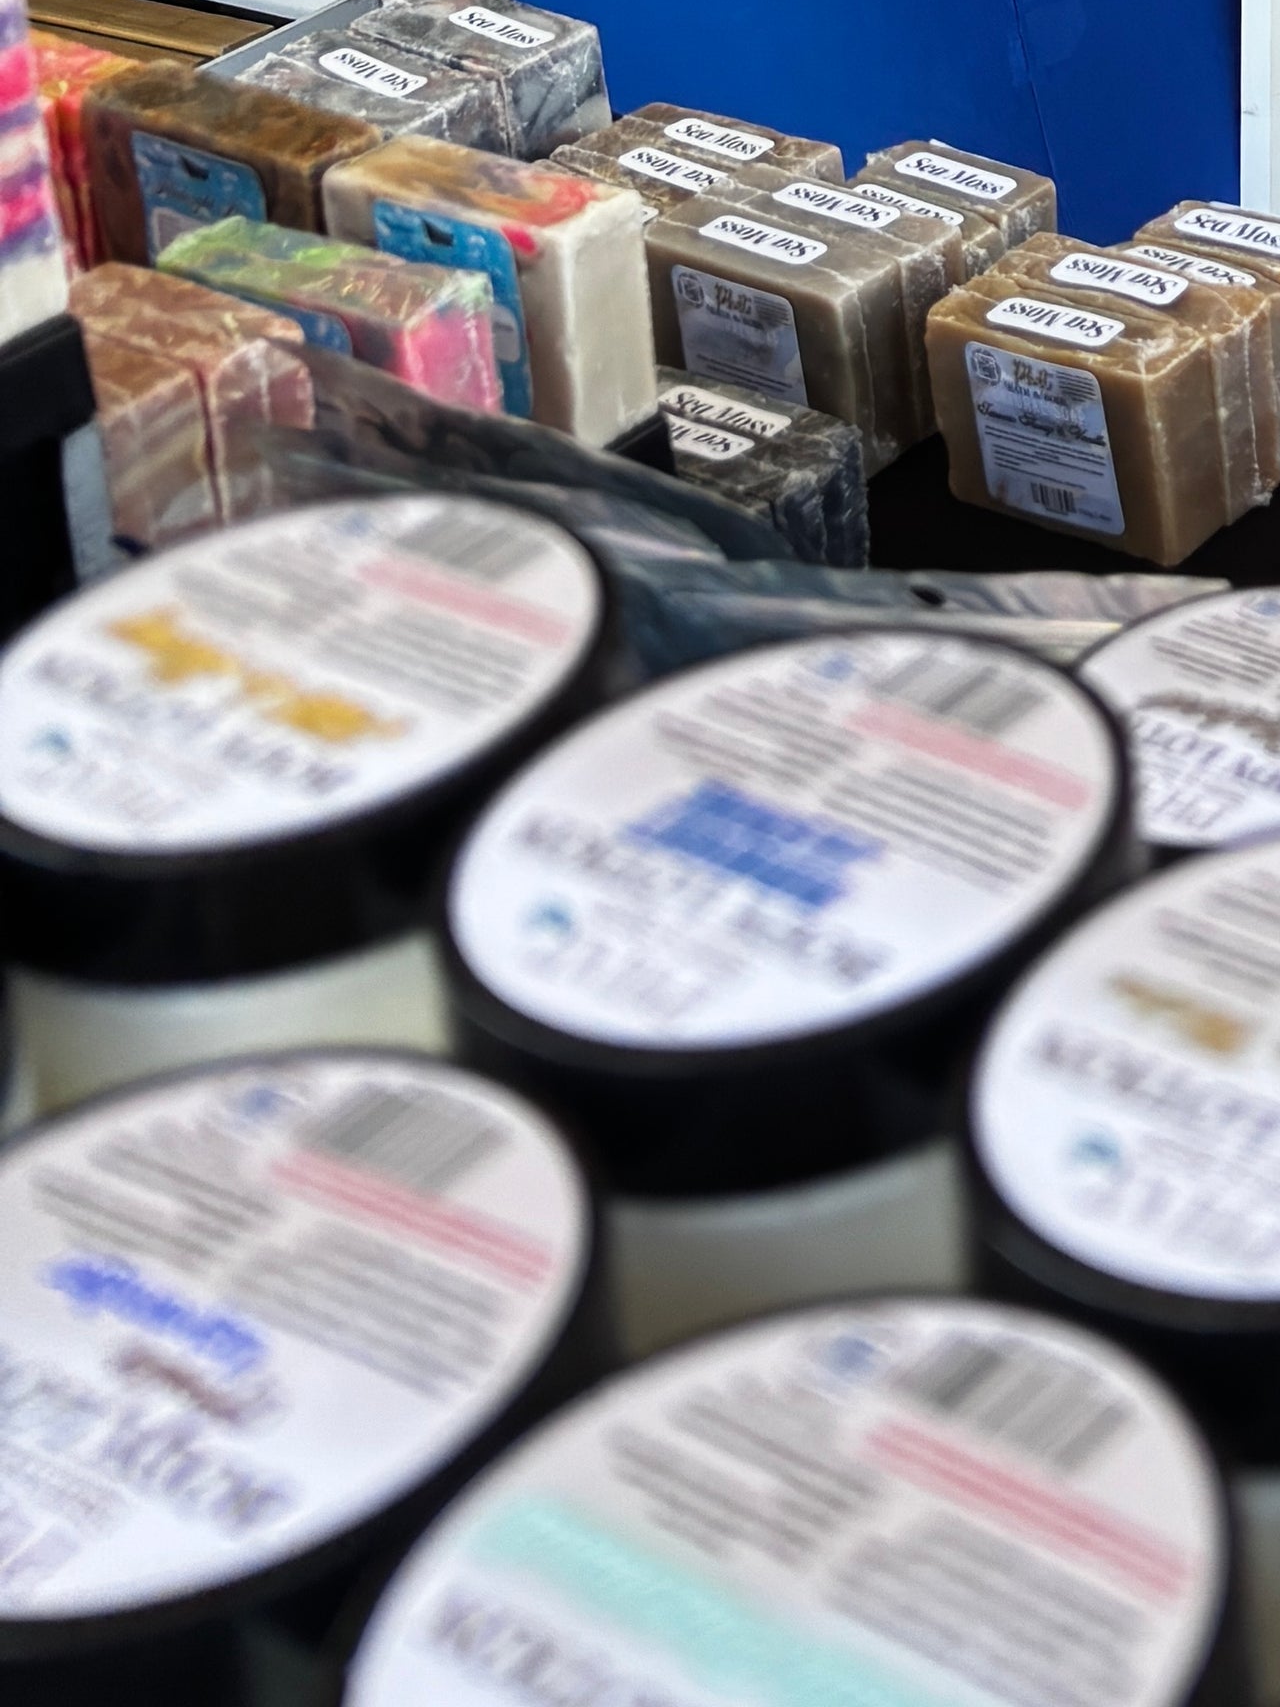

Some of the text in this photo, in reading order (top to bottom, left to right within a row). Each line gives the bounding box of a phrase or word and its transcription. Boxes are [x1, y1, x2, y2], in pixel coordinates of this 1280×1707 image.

[459, 10, 494, 33] Sea
[676, 123, 762, 156] Sea Moss
[632, 150, 688, 180] Moss
[907, 157, 1004, 195] Sea Moss
[788, 187, 893, 224] Sea Moss
[714, 219, 819, 258] Sea Moss
[1188, 213, 1226, 235] Sea
[1139, 246, 1191, 271] Moss
[1066, 257, 1180, 296] Sea Moss
[1002, 301, 1115, 339] Sea Moss
[676, 391, 714, 416] Sea
